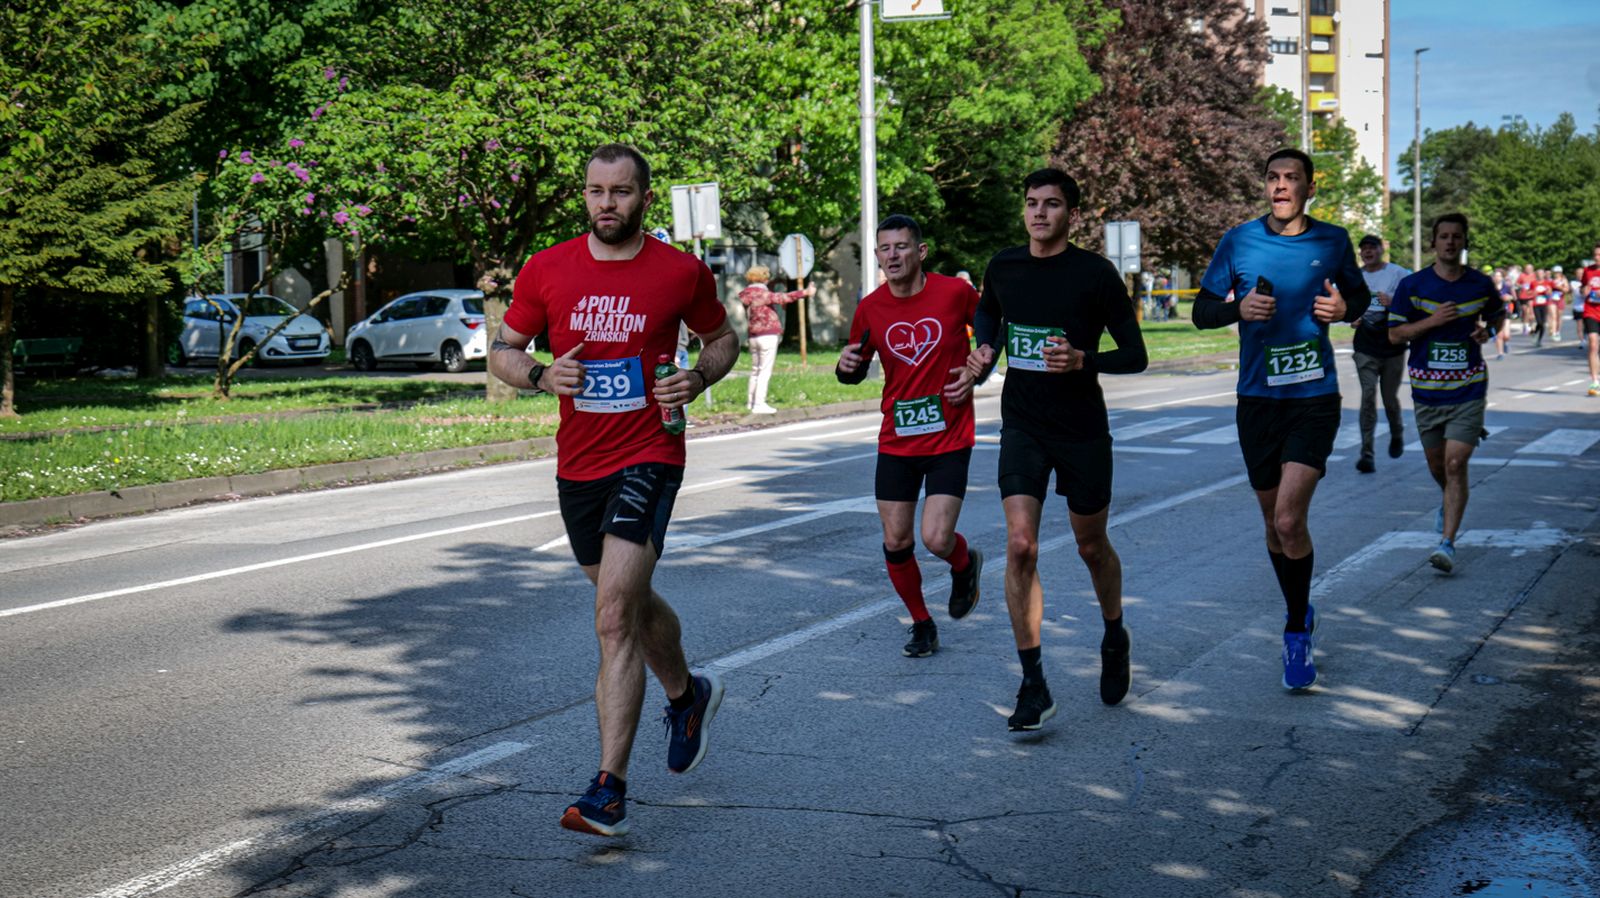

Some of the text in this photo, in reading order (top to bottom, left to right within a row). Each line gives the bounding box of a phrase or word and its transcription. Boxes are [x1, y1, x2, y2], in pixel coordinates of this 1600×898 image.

[587, 295, 631, 314] POLU
[569, 312, 647, 333] MARATON
[584, 331, 630, 343] ZRINSKIH
[1269, 350, 1320, 375] 1232
[1431, 348, 1467, 362] 1258
[583, 374, 631, 398] 239
[895, 404, 941, 426] 1245
